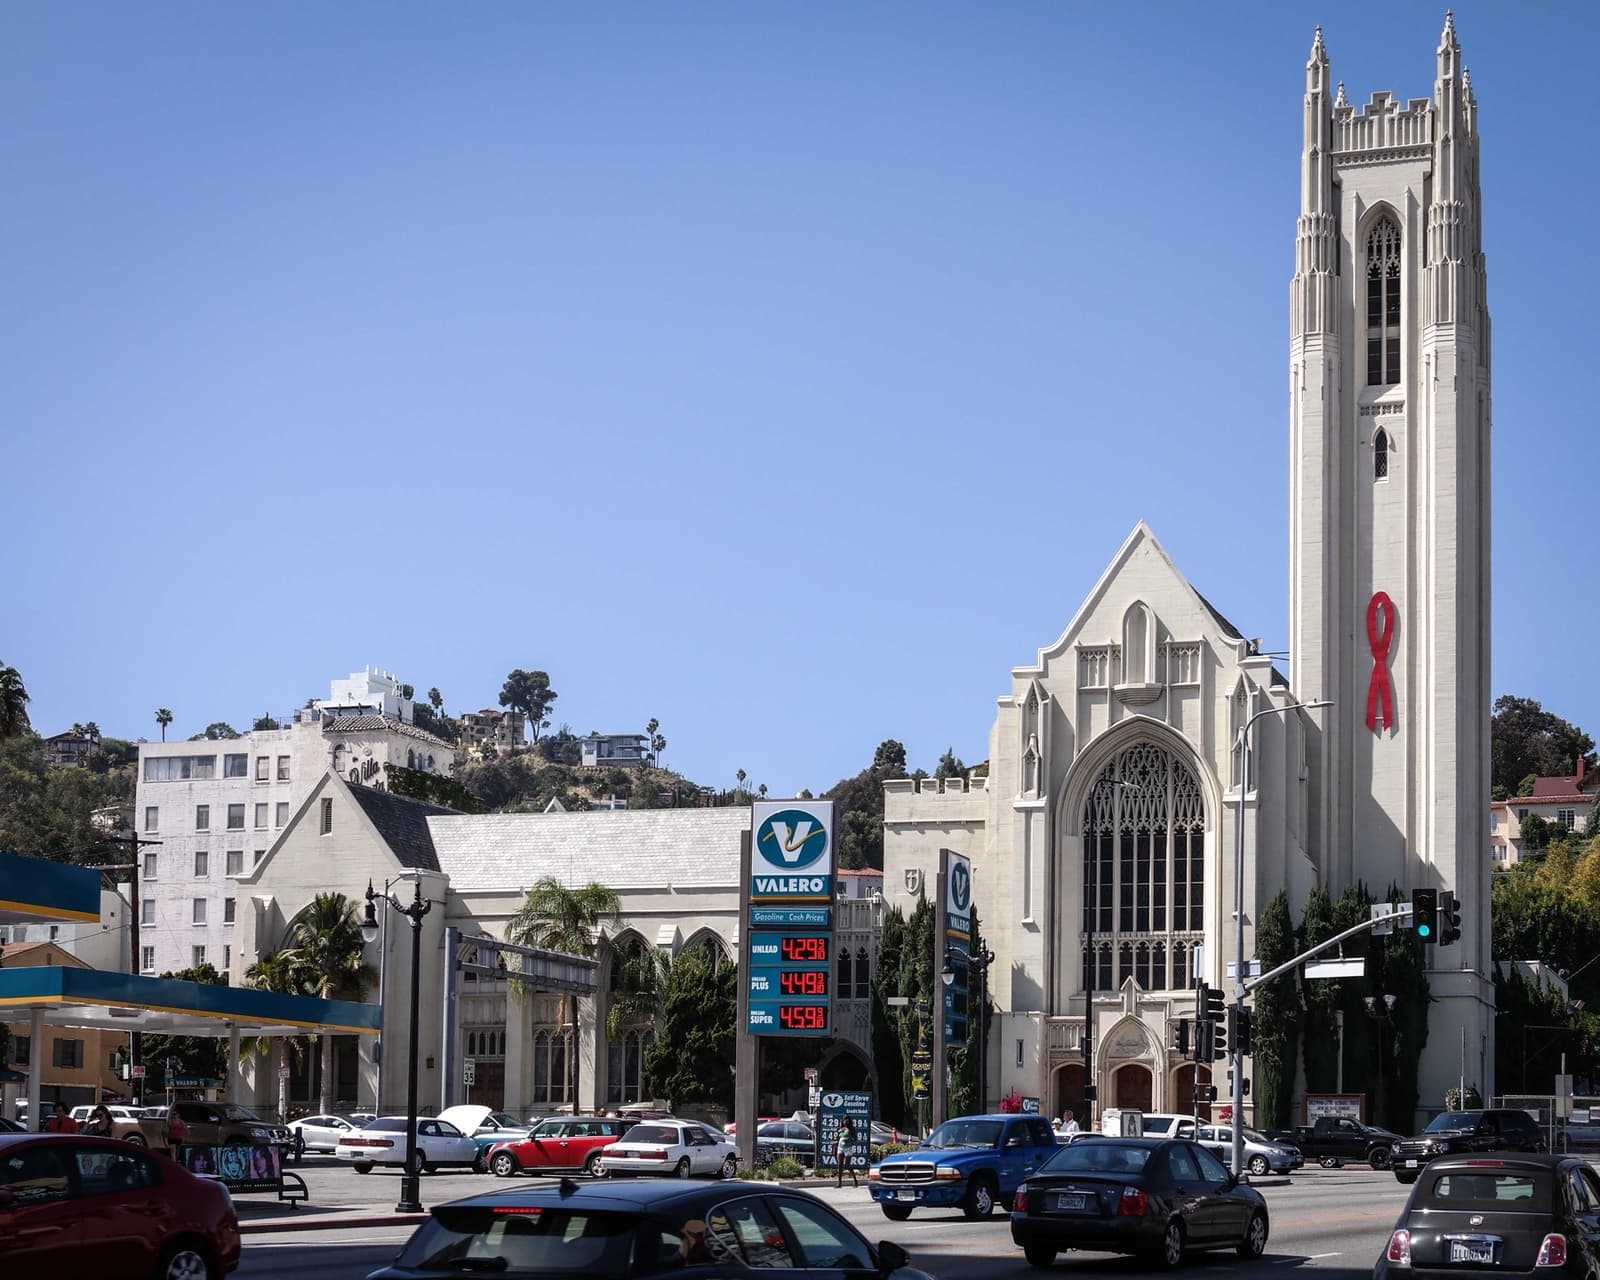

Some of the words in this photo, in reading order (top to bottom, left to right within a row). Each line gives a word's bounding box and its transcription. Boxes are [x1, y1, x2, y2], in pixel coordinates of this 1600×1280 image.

[755, 878, 824, 892] VALERO
[754, 913, 784, 921] Gasoline
[788, 913, 805, 921] Cash
[805, 913, 824, 921] Prices
[950, 916, 970, 932] VALERO
[752, 945, 778, 953] UNLEAD
[751, 981, 769, 990] PLUS
[750, 1015, 773, 1024] SUPER
[465, 1072, 474, 1083] 35
[822, 1156, 866, 1165] VARO
